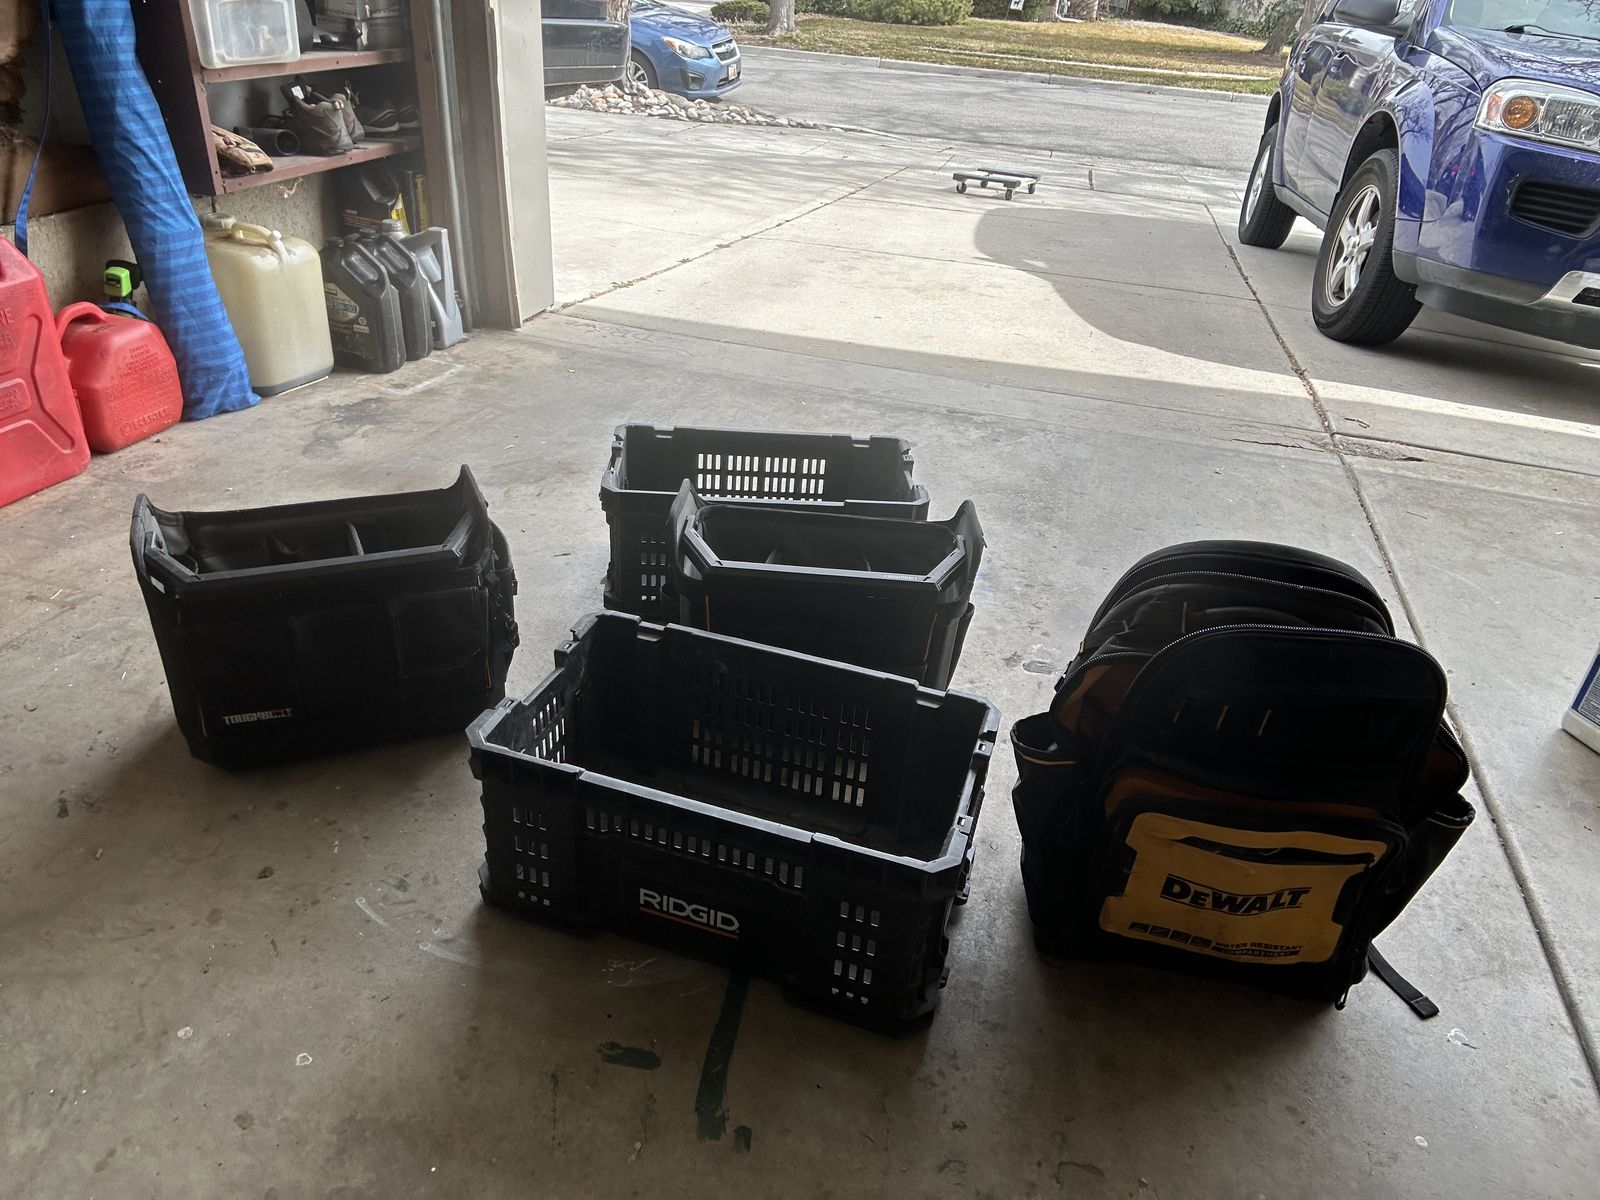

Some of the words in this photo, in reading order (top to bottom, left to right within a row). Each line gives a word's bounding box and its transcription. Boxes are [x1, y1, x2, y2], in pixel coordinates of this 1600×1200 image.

[222, 707, 293, 725] TOUGHBT
[640, 888, 740, 931] RIDGID
[1215, 941, 1248, 949] WATER
[1249, 941, 1305, 951] RESISTANT
